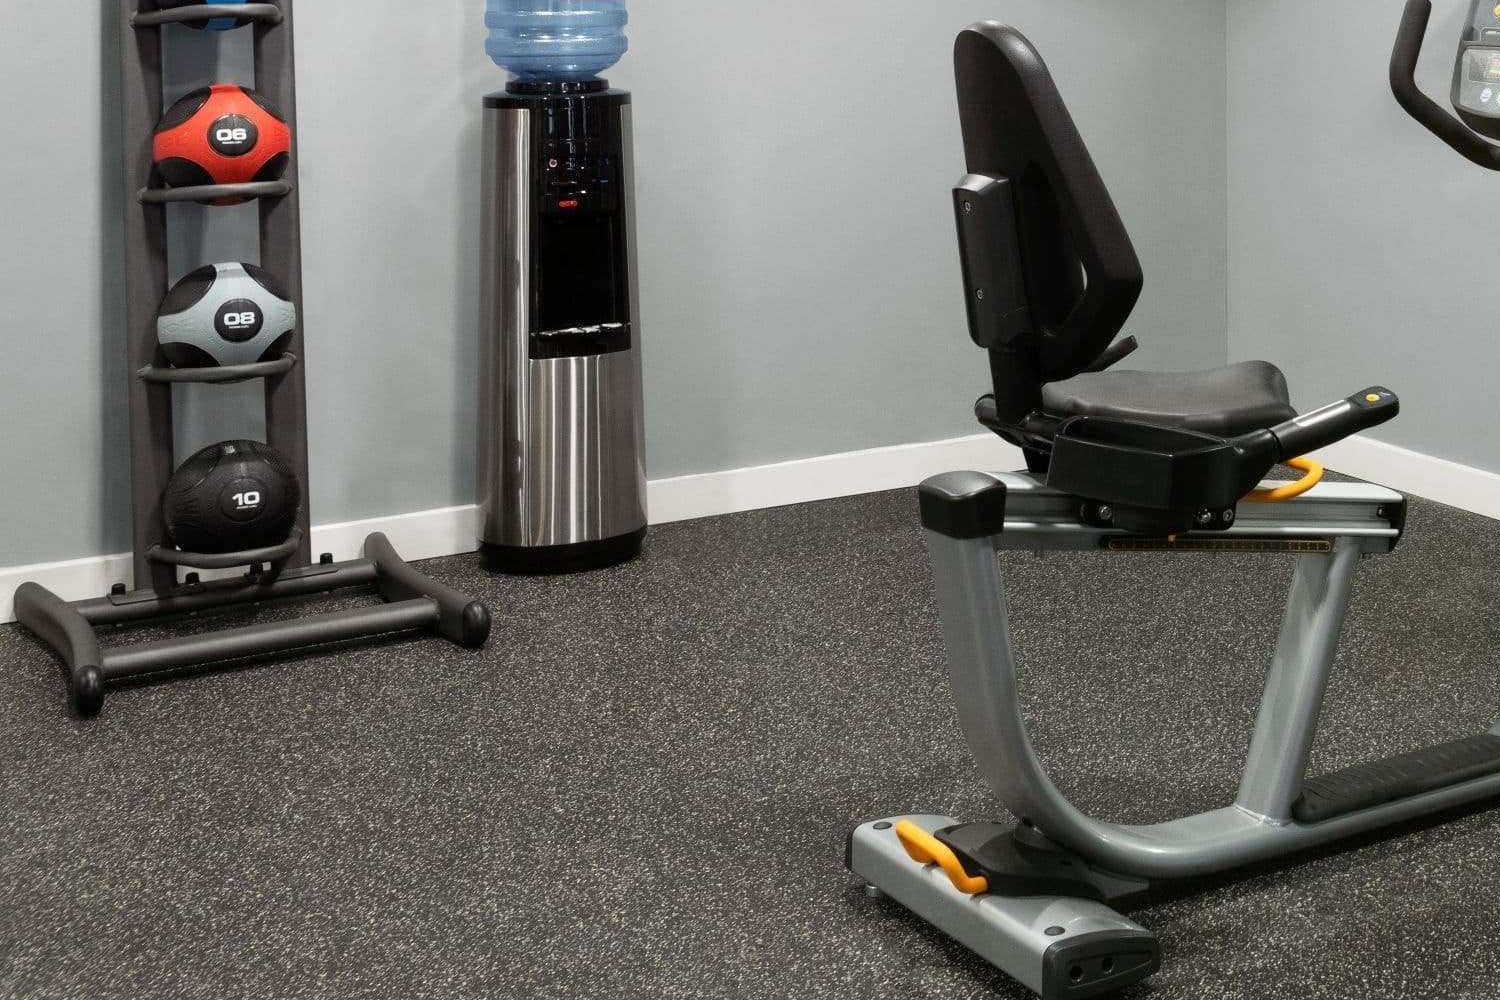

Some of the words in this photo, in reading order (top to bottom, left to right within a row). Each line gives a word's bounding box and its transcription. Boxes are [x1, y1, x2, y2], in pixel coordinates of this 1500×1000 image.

[216, 128, 247, 141] 06
[223, 311, 255, 326] 08
[231, 491, 260, 506] 10
